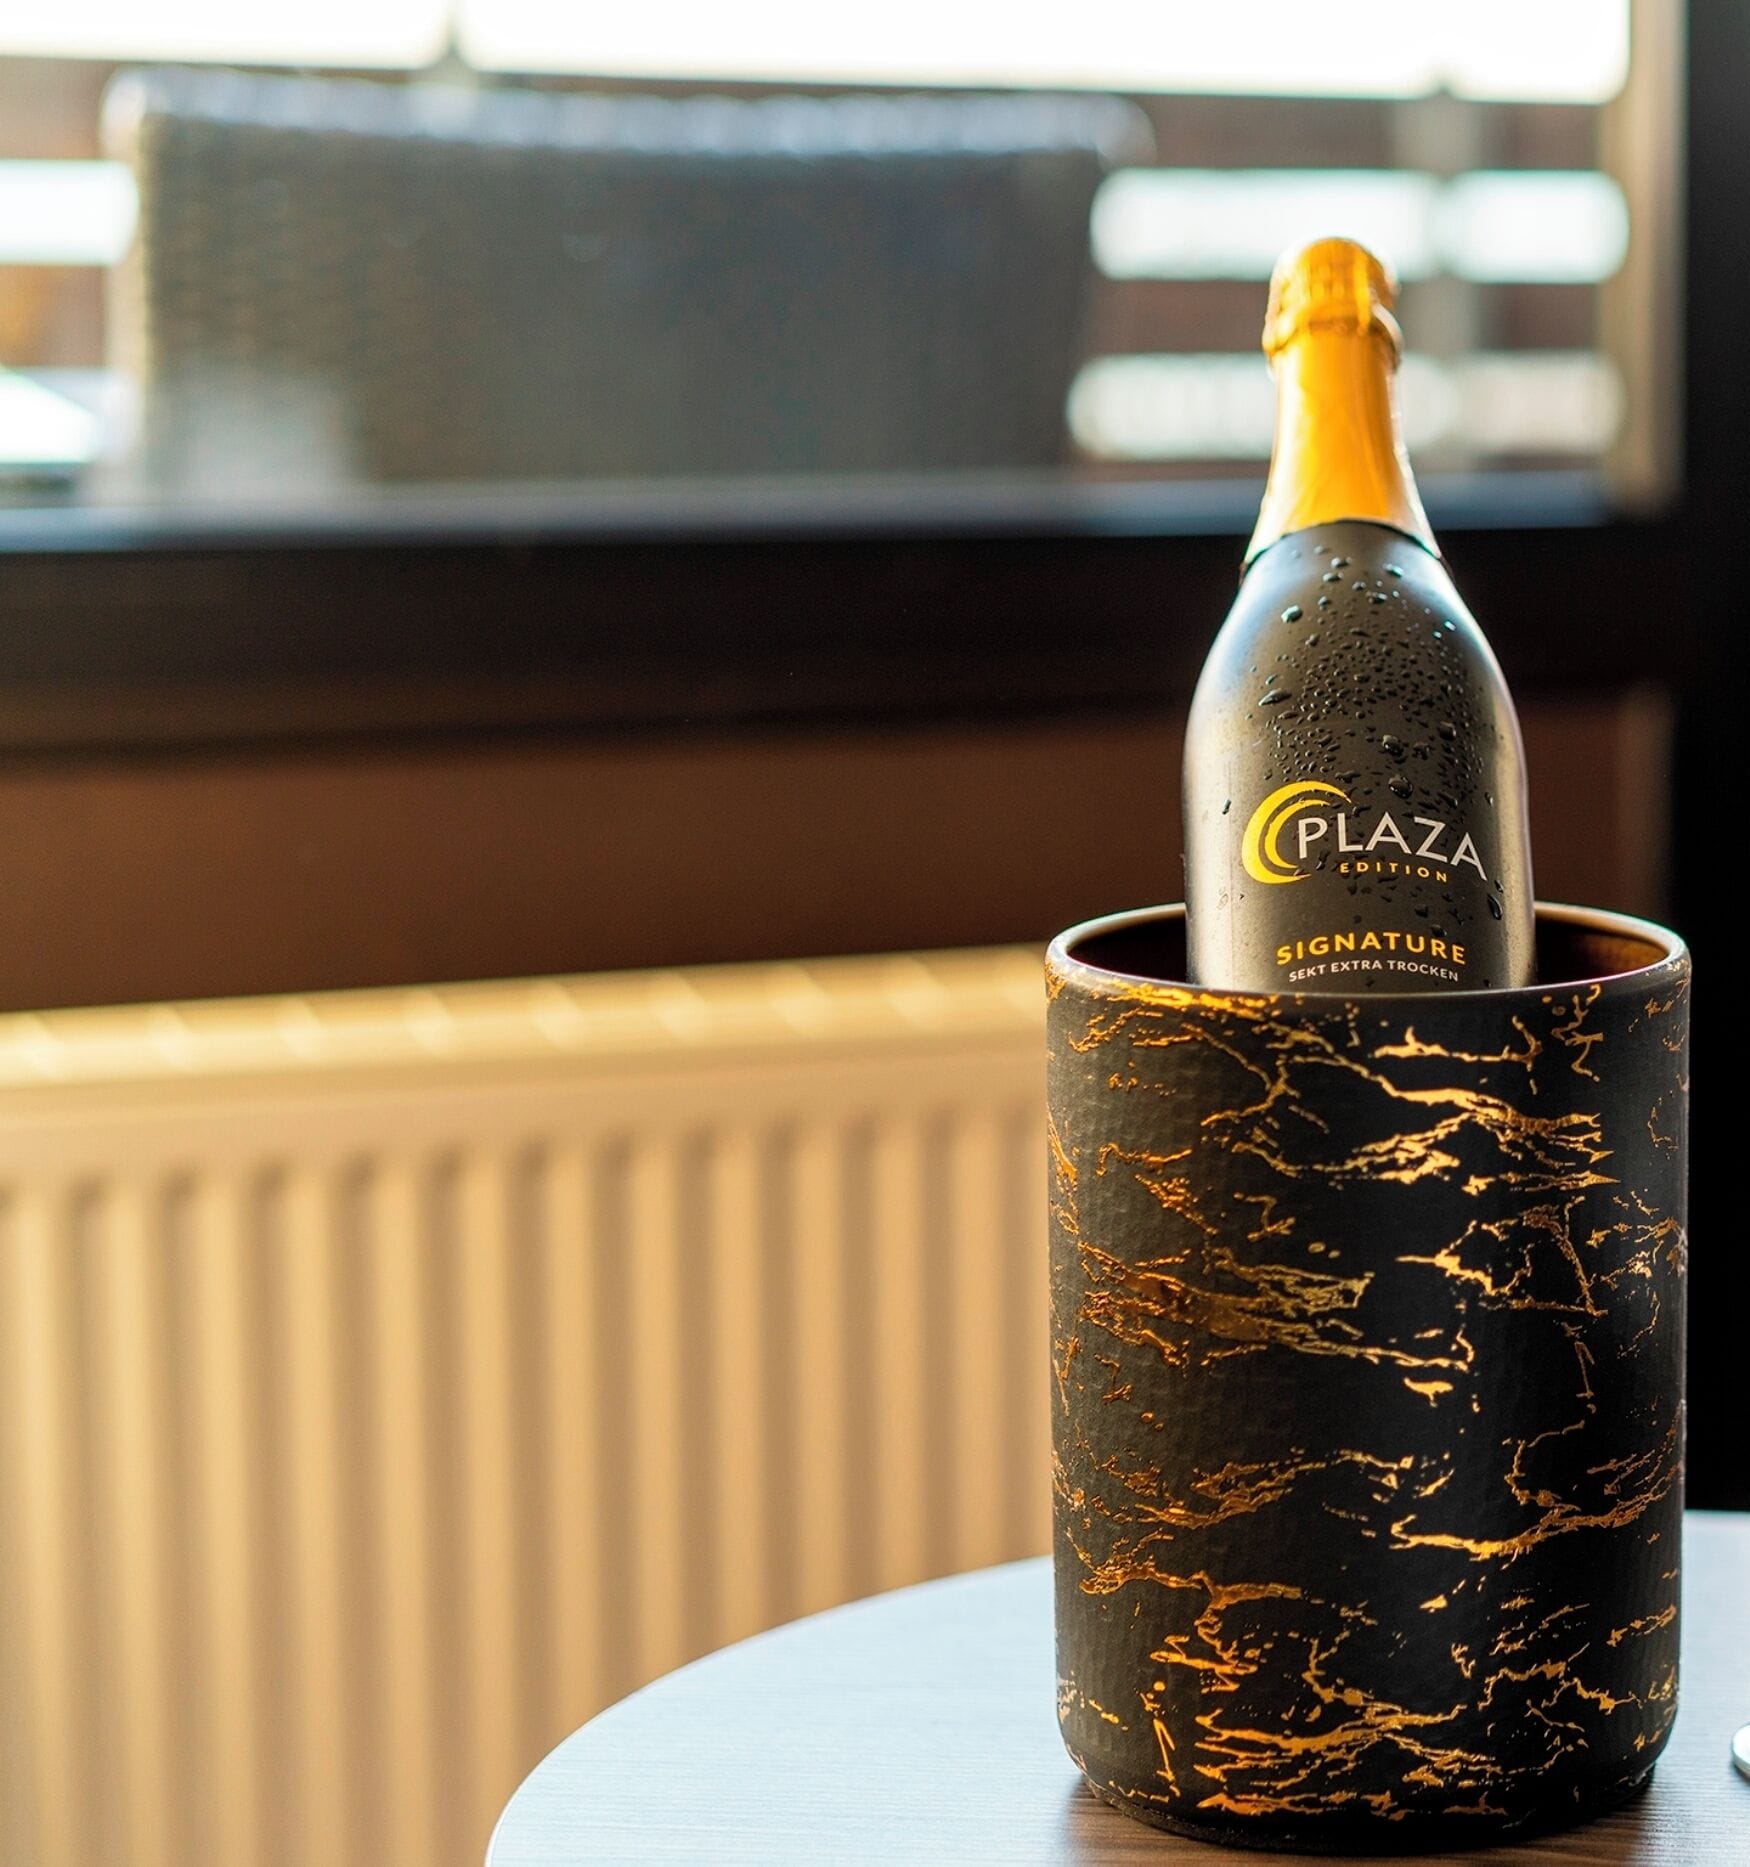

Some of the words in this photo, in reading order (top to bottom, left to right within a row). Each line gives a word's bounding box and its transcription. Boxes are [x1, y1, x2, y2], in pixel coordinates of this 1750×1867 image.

[1298, 811, 1488, 881] PLAZA
[1339, 861, 1448, 883] EDITION
[1275, 931, 1467, 966] SIGNATURE
[1288, 964, 1326, 982] SEKT
[1330, 959, 1383, 974] EXTRA
[1386, 959, 1459, 982] TROCKEN
